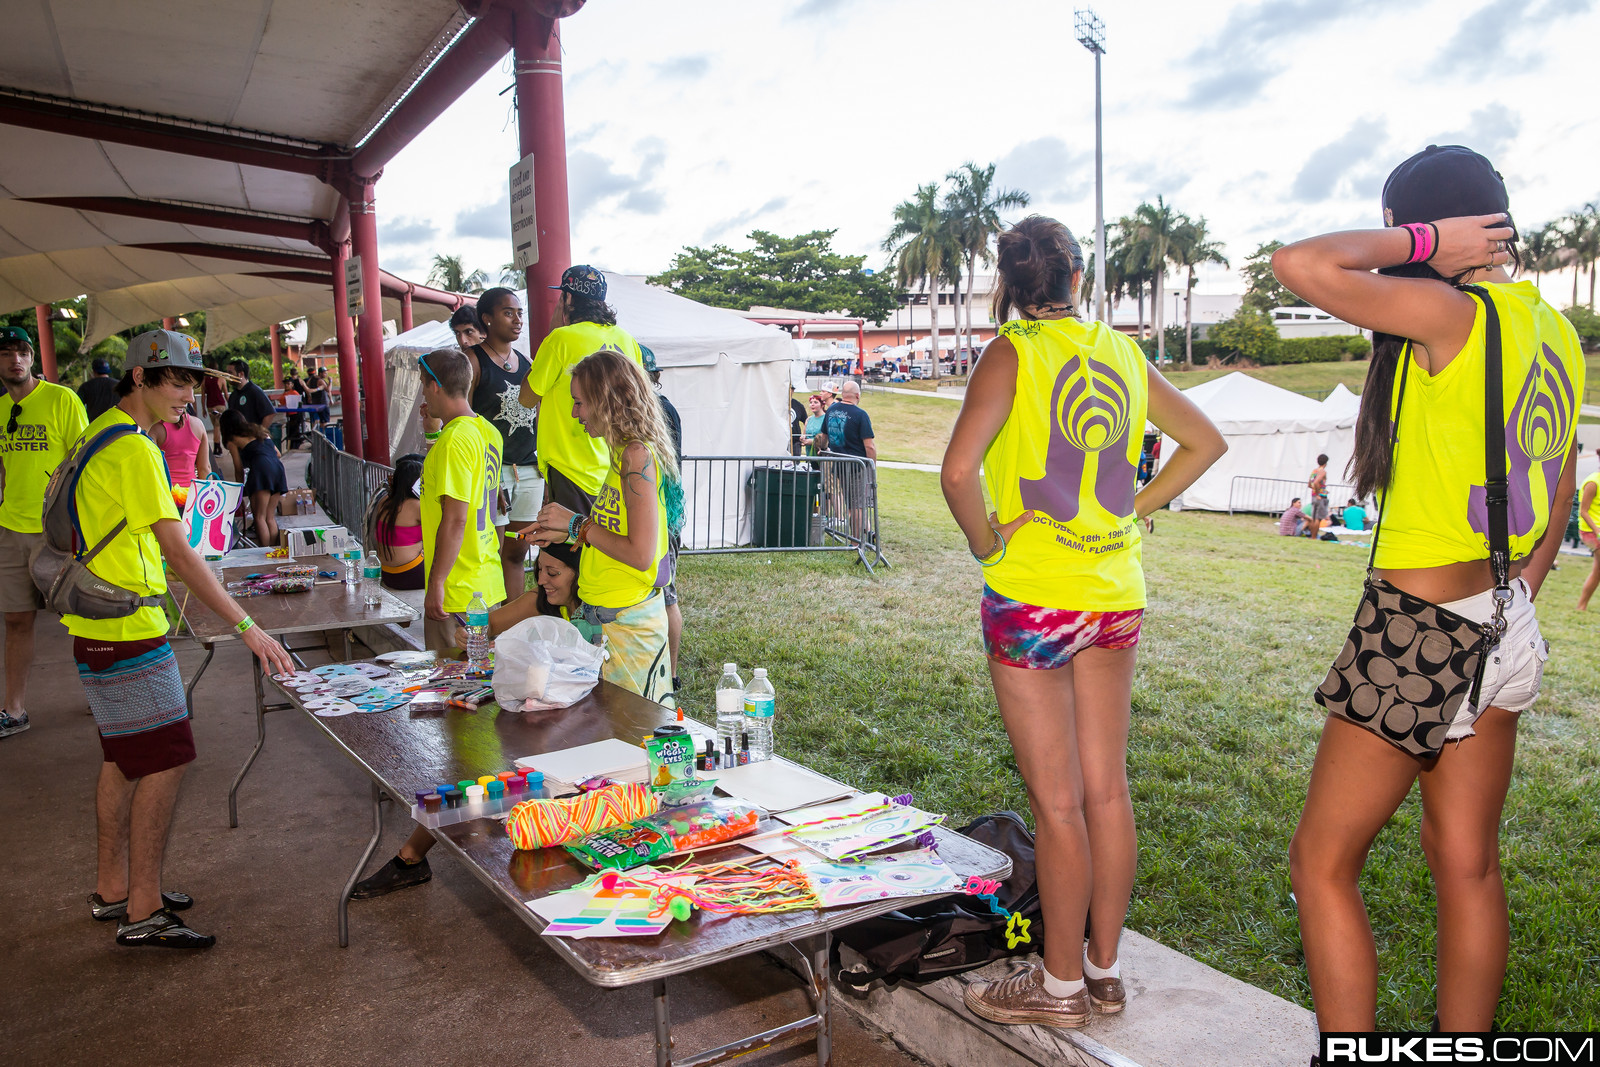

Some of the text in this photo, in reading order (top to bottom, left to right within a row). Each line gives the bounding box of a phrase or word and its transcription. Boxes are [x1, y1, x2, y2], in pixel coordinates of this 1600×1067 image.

[511, 184, 532, 204] BEVERAGES
[513, 214, 534, 232] RESTROOMS
[1080, 534, 1101, 543] 18th
[1108, 529, 1124, 539] 19th
[1124, 523, 1133, 535] 201
[1055, 534, 1124, 554] MIAMI, FLORIDA
[656, 746, 687, 758] WIGGLY
[664, 755, 683, 764] EYES
